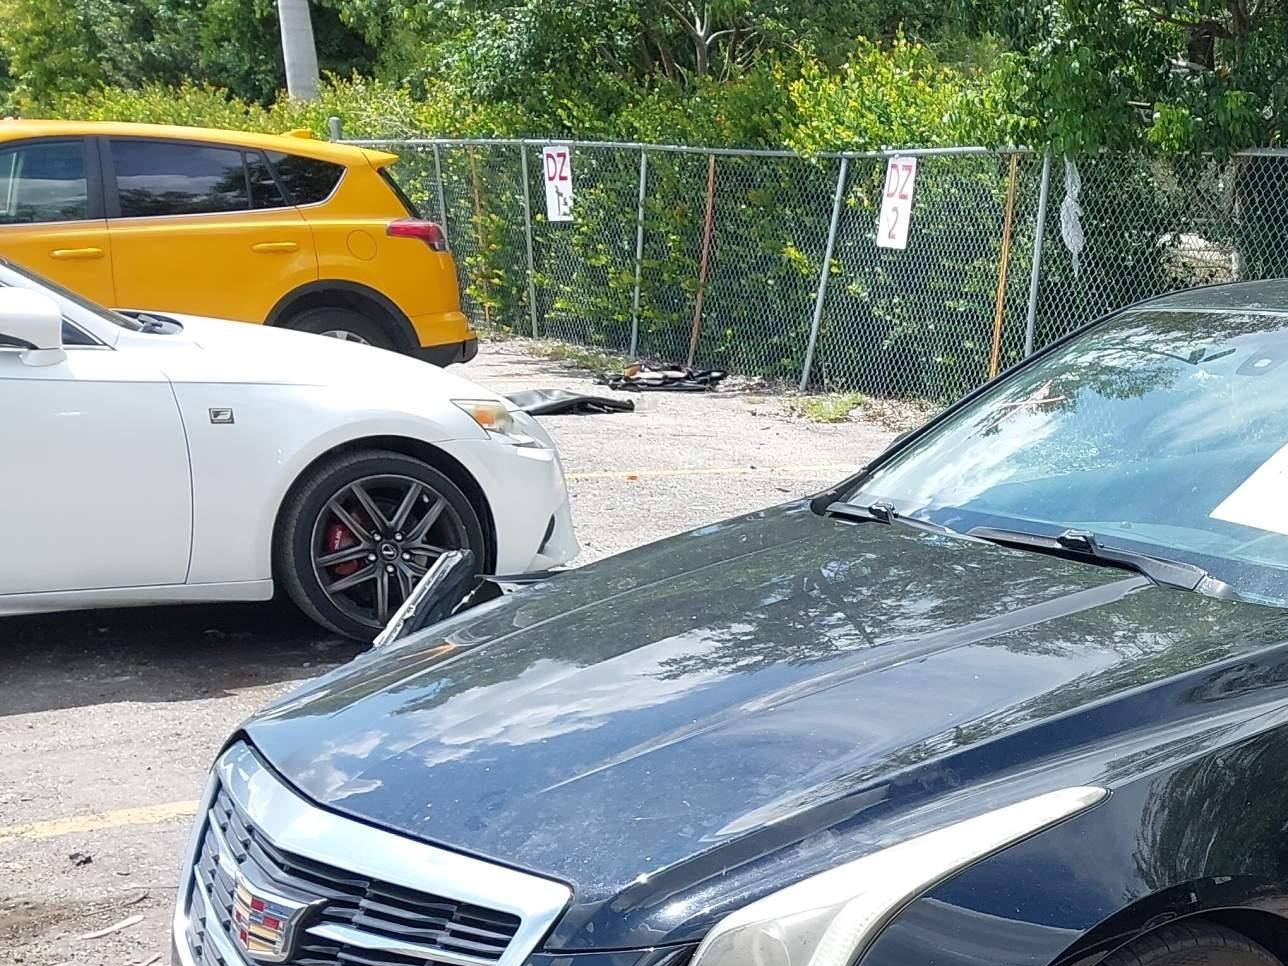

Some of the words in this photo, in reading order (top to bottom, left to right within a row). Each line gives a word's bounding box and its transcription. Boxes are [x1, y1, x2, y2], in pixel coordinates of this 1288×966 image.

[545, 152, 569, 182] DZ
[886, 163, 914, 201] DZ
[887, 205, 900, 241] 2
